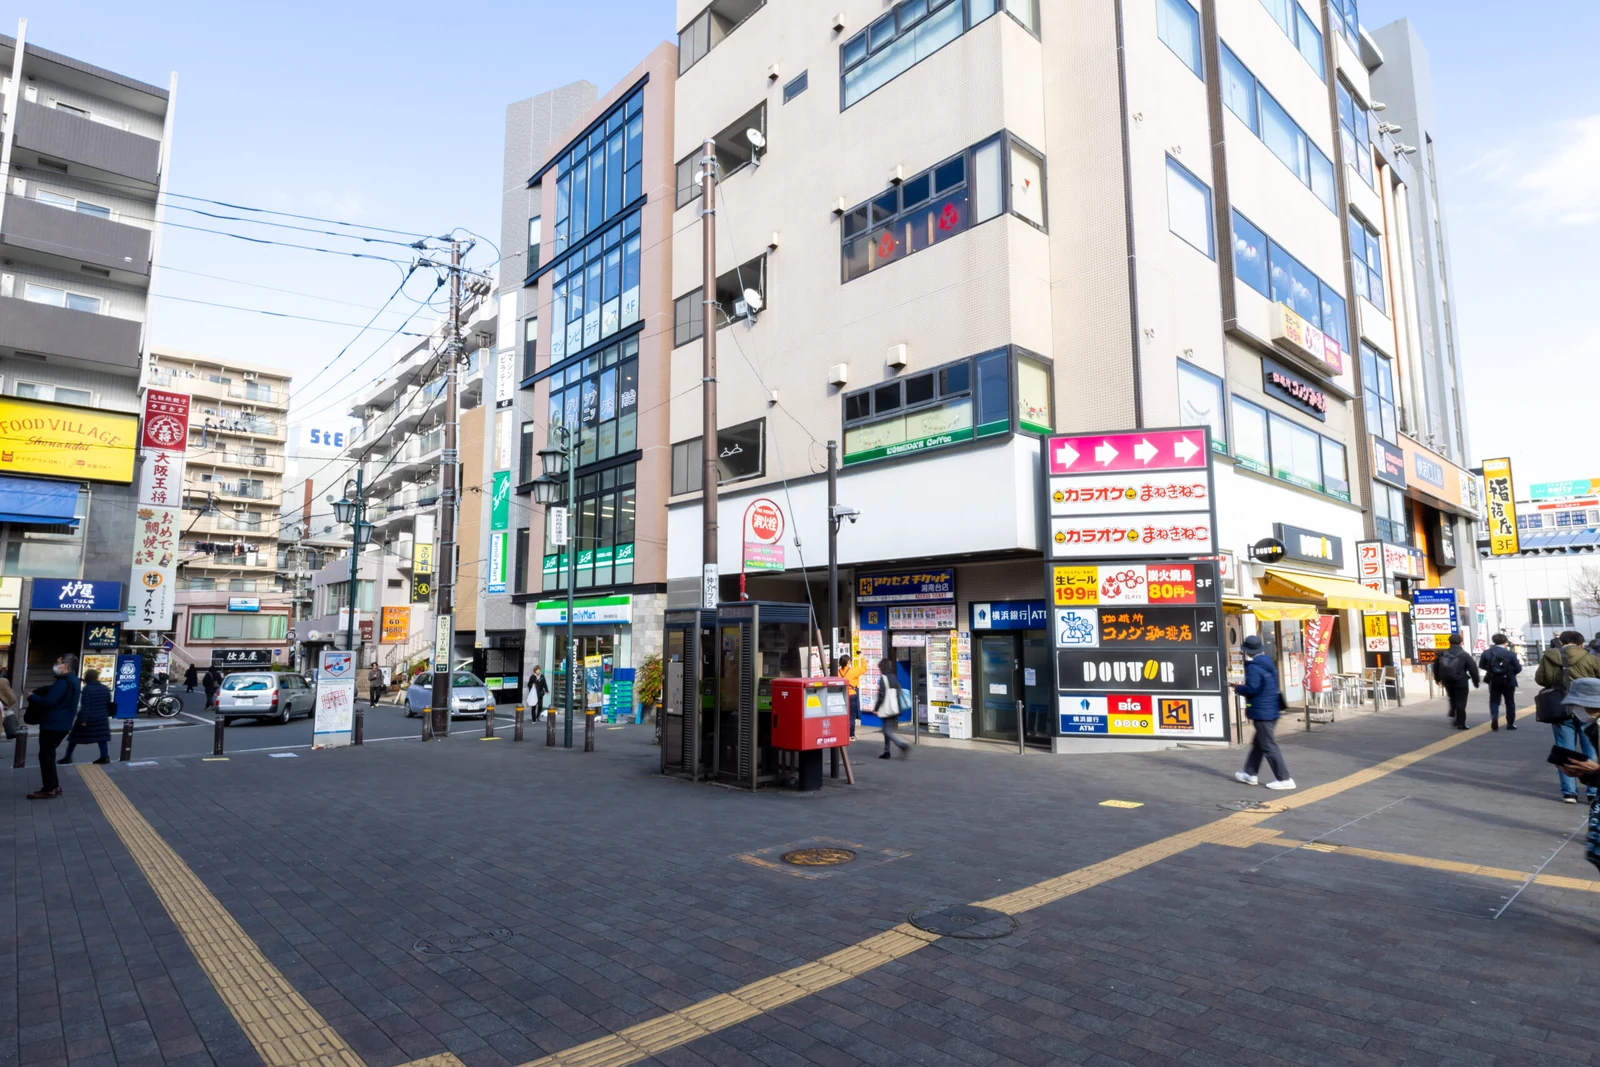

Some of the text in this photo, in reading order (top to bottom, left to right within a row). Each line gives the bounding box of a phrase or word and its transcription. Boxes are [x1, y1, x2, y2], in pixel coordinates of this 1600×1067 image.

[0, 418, 121, 447] FOOD VILLAGE
[926, 435, 952, 447] Coffee
[151, 451, 170, 503] 大阪王将
[1064, 484, 1206, 502] カラオケ まねきねこ
[753, 514, 777, 531] 消火栓
[1066, 526, 1208, 543] カラオケ まねきねこ
[1256, 545, 1282, 555] DOUTOR
[1496, 540, 1513, 551] 3F
[492, 535, 500, 581] FamilyMart
[1056, 576, 1097, 586] 生ビール
[1148, 569, 1192, 582] 炭火焼鳥
[921, 583, 949, 592] 湘南台店
[1196, 579, 1213, 588] 3F
[59, 580, 95, 600] 大戸屋
[1056, 587, 1098, 600] 199円
[992, 610, 1047, 621] 横浜銀行 AT
[1199, 621, 1214, 632] 2F
[1102, 624, 1193, 642] コメダ珈琲店
[1083, 659, 1175, 682] DOUTOR
[1199, 666, 1213, 677] 1F
[1117, 699, 1142, 711] BIG
[1202, 713, 1215, 722] 1F
